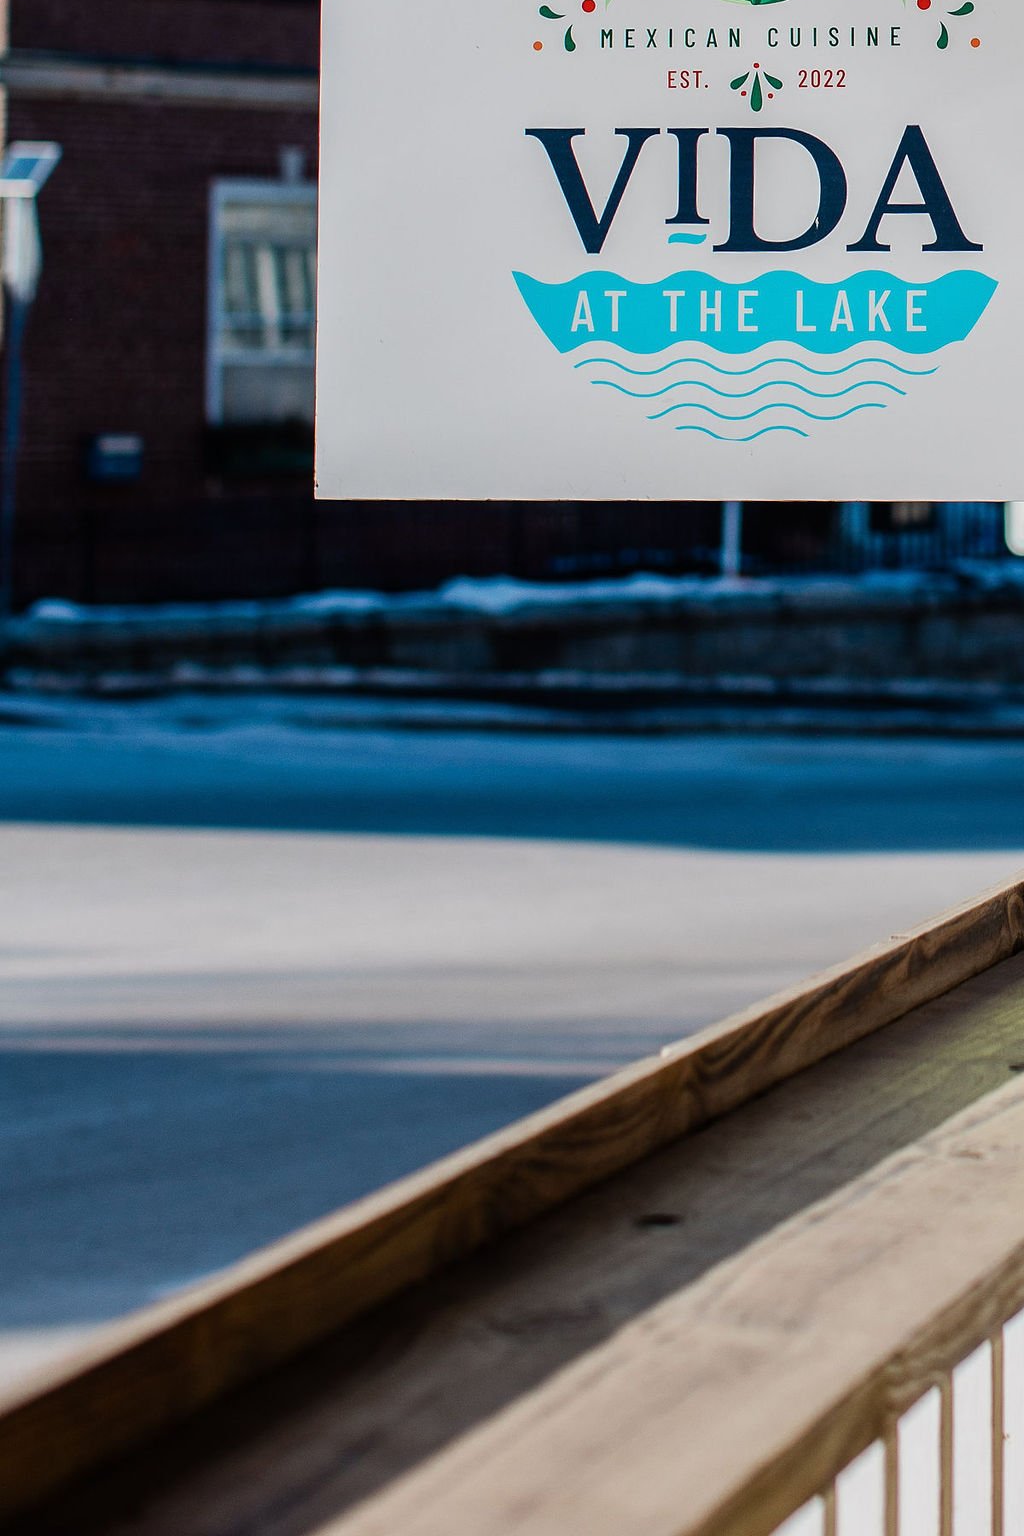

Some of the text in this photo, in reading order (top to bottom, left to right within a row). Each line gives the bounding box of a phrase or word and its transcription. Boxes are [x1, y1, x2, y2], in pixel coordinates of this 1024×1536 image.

[599, 26, 903, 49] MEXICAN CUISINE
[667, 68, 847, 90] EST. 2022
[524, 123, 984, 255] VIDA
[570, 289, 929, 333] AT THE LAKE
